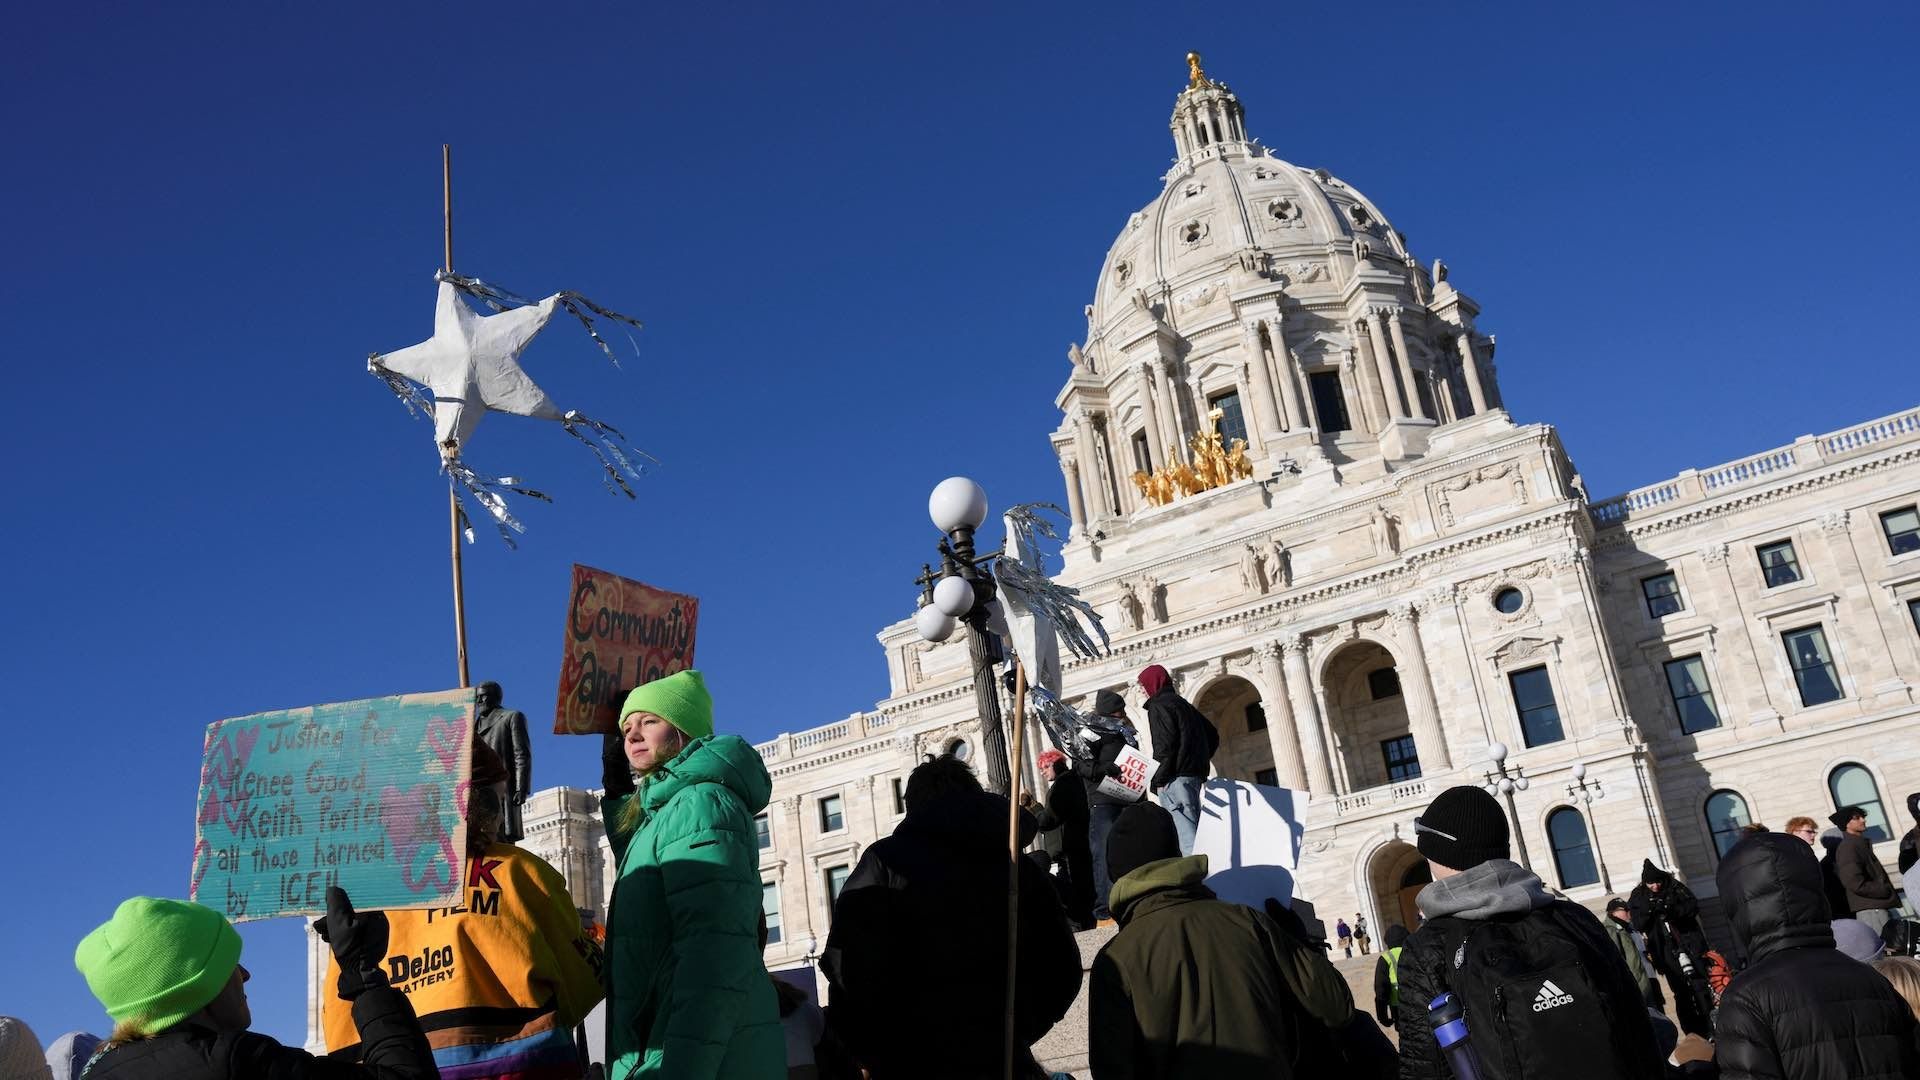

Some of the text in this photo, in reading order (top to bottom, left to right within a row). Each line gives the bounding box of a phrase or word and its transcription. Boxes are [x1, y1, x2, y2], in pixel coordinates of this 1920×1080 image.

[573, 580, 690, 660] Community
[266, 720, 344, 753] Justice
[1119, 763, 1146, 783] OUT
[1125, 755, 1148, 774] ICE
[1112, 775, 1144, 793] OW!
[241, 797, 303, 840] Keith
[217, 844, 240, 874] all
[252, 842, 299, 873] those
[226, 877, 249, 916] by
[388, 944, 454, 985] Delco
[393, 967, 455, 994] ATTERY
[1532, 993, 1575, 1012] adidas
